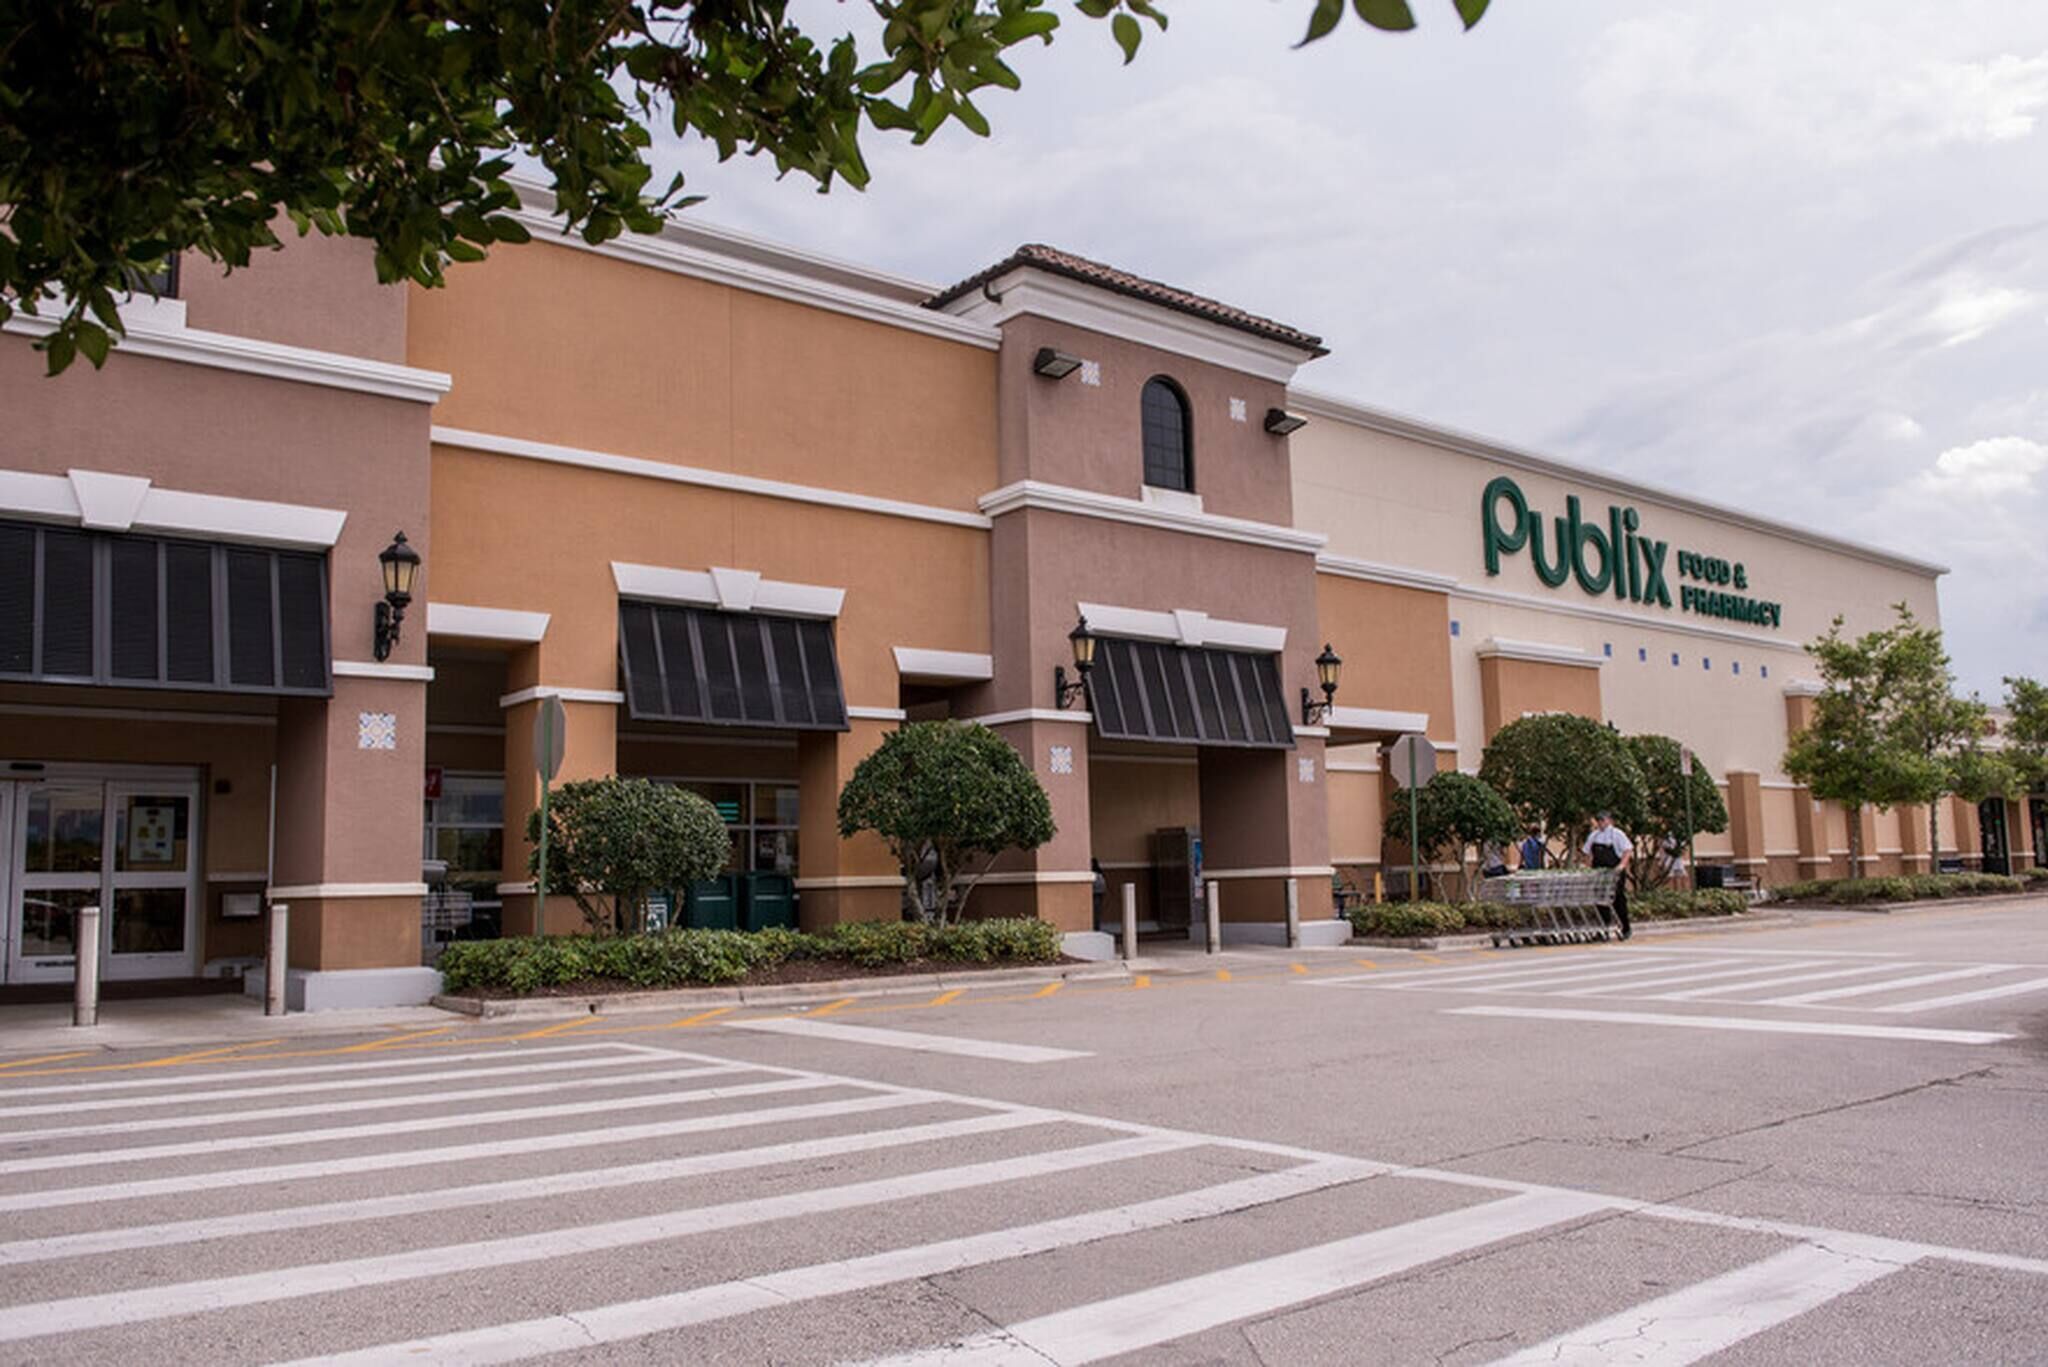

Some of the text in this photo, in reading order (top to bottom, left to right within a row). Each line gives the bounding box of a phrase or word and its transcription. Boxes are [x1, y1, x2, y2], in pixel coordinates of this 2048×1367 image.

[1482, 475, 1672, 608] Publix
[1678, 550, 1748, 589] FOOD &
[1681, 585, 1781, 628] PHARMACY
